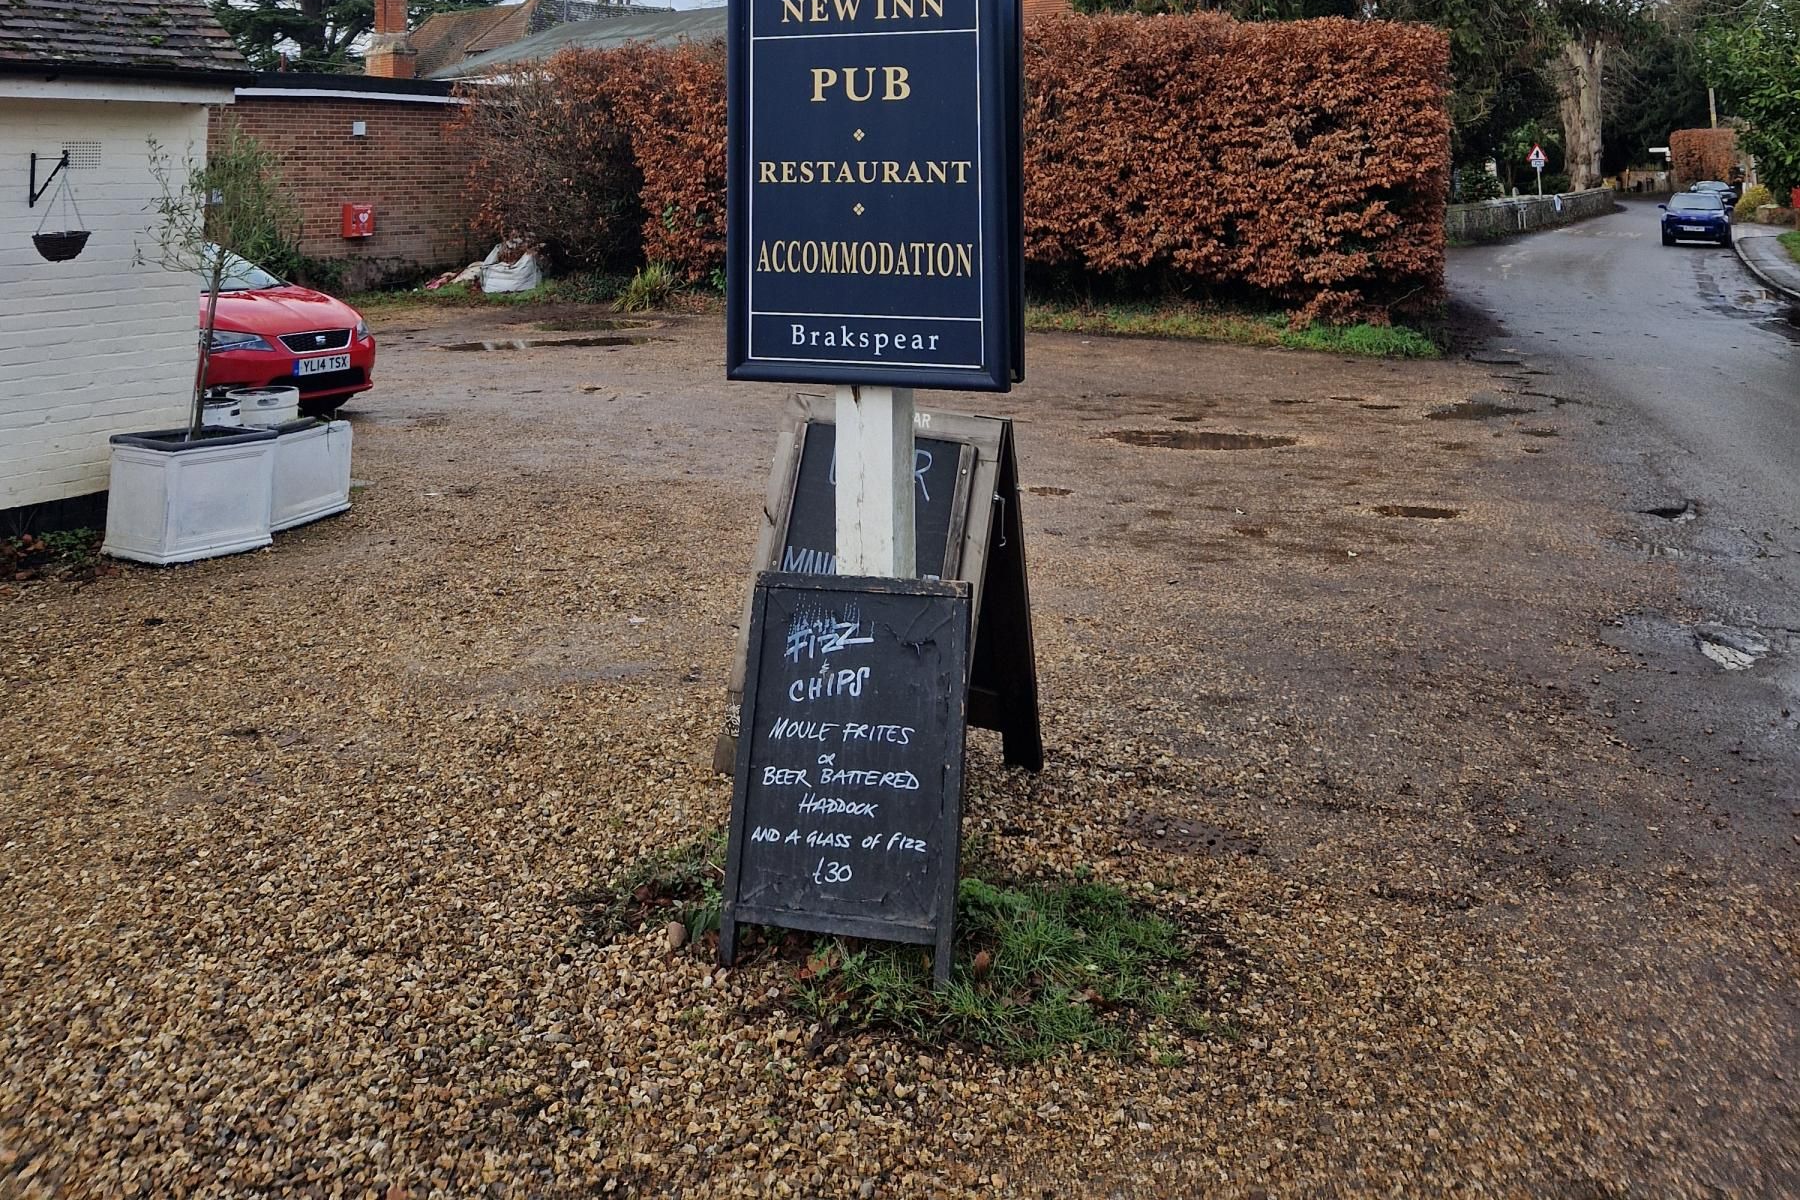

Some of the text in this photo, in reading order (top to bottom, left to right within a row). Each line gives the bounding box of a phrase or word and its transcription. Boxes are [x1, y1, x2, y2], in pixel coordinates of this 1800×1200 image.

[810, 66, 911, 102] PUB
[758, 161, 971, 184] RESTAURANT
[756, 240, 973, 278] ACCOMMODATION
[791, 324, 939, 355] Brakspear
[303, 356, 347, 372] YL14 TSX
[784, 621, 874, 663] FIZZ
[789, 666, 870, 702] CHIPS
[768, 717, 915, 745] MOULE FRITES
[762, 766, 920, 790] BEER BATTERED
[799, 792, 879, 818] HADDOCK
[751, 826, 780, 843] AND
[784, 828, 801, 846] A
[806, 830, 852, 848] GLASS
